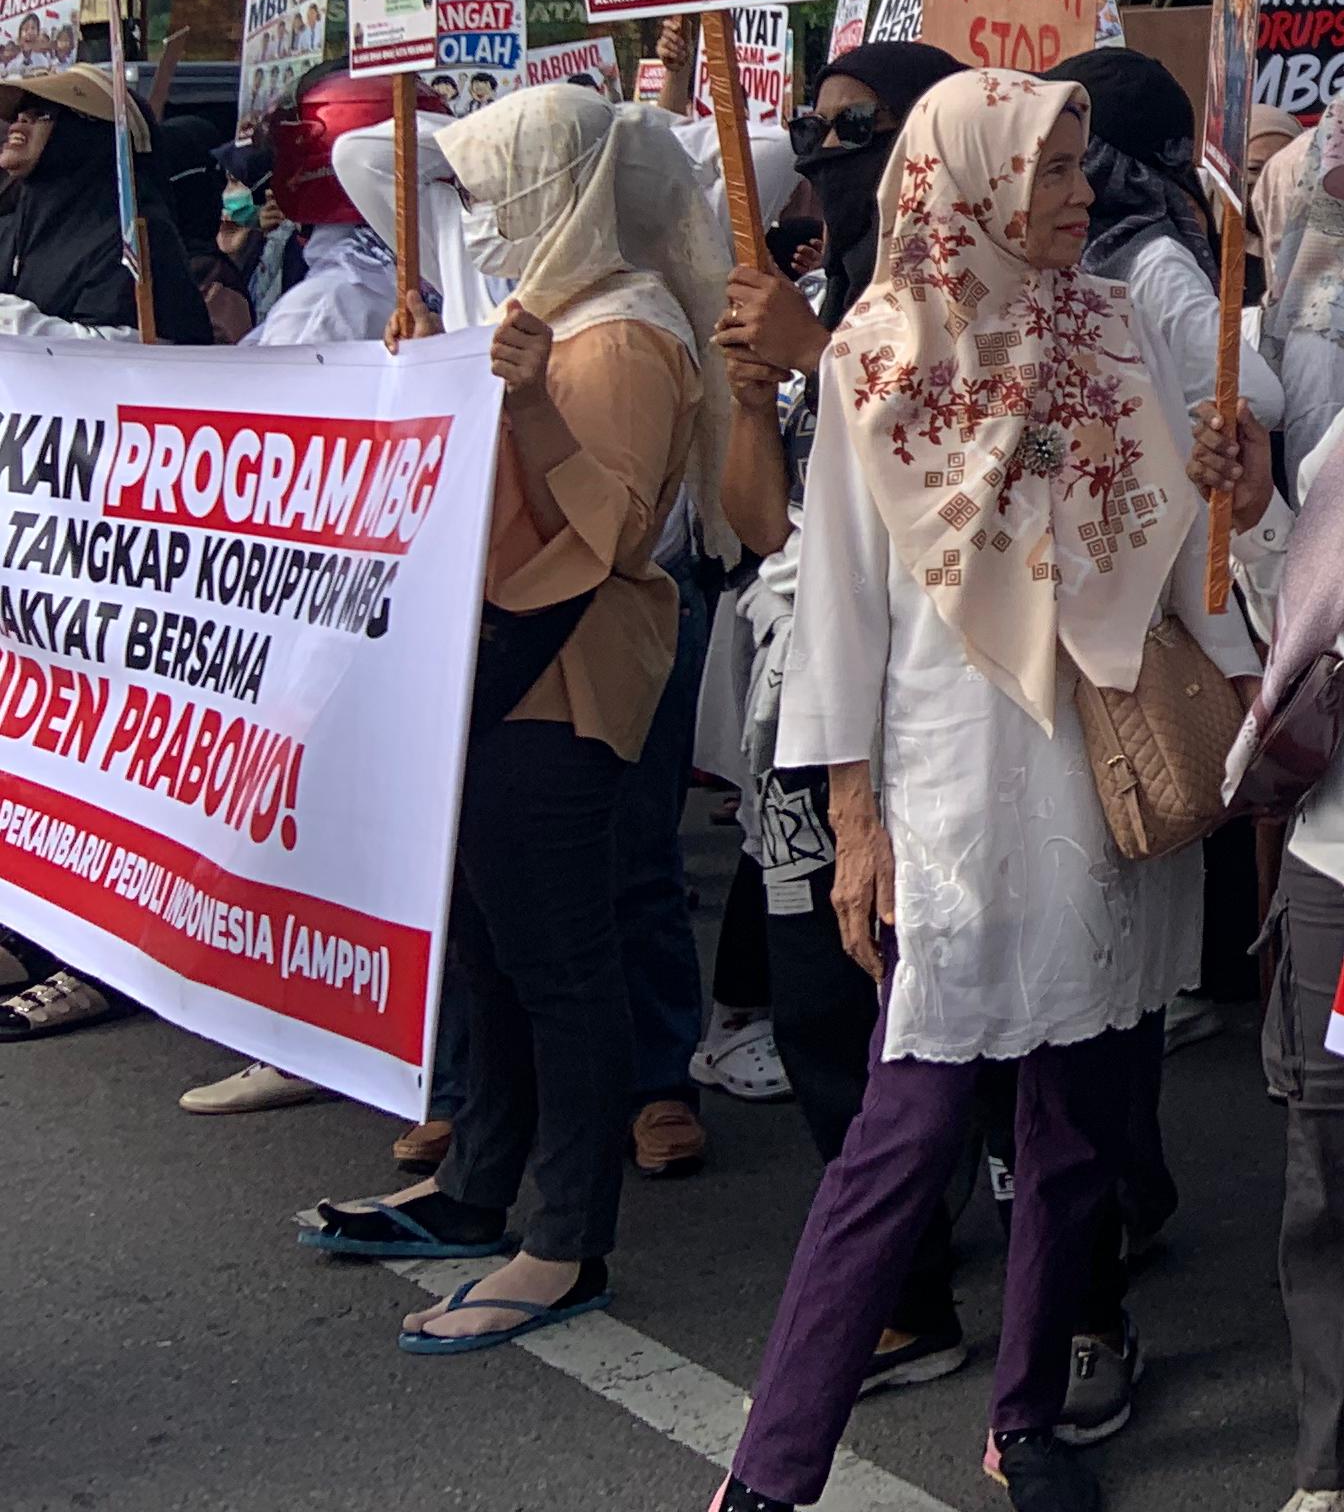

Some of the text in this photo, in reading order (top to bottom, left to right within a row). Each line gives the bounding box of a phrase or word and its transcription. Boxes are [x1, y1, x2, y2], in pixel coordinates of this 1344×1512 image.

[0, 413, 442, 543] KAN PROGRAM MBG
[2, 510, 190, 593] TANGKAP
[195, 535, 352, 627] KORUPTOR
[125, 607, 273, 705] BERSAMA
[100, 684, 305, 852] PRABOWO!
[0, 799, 390, 1014] PEKANBARU PEDULI INDONESIA (AMPPI)
